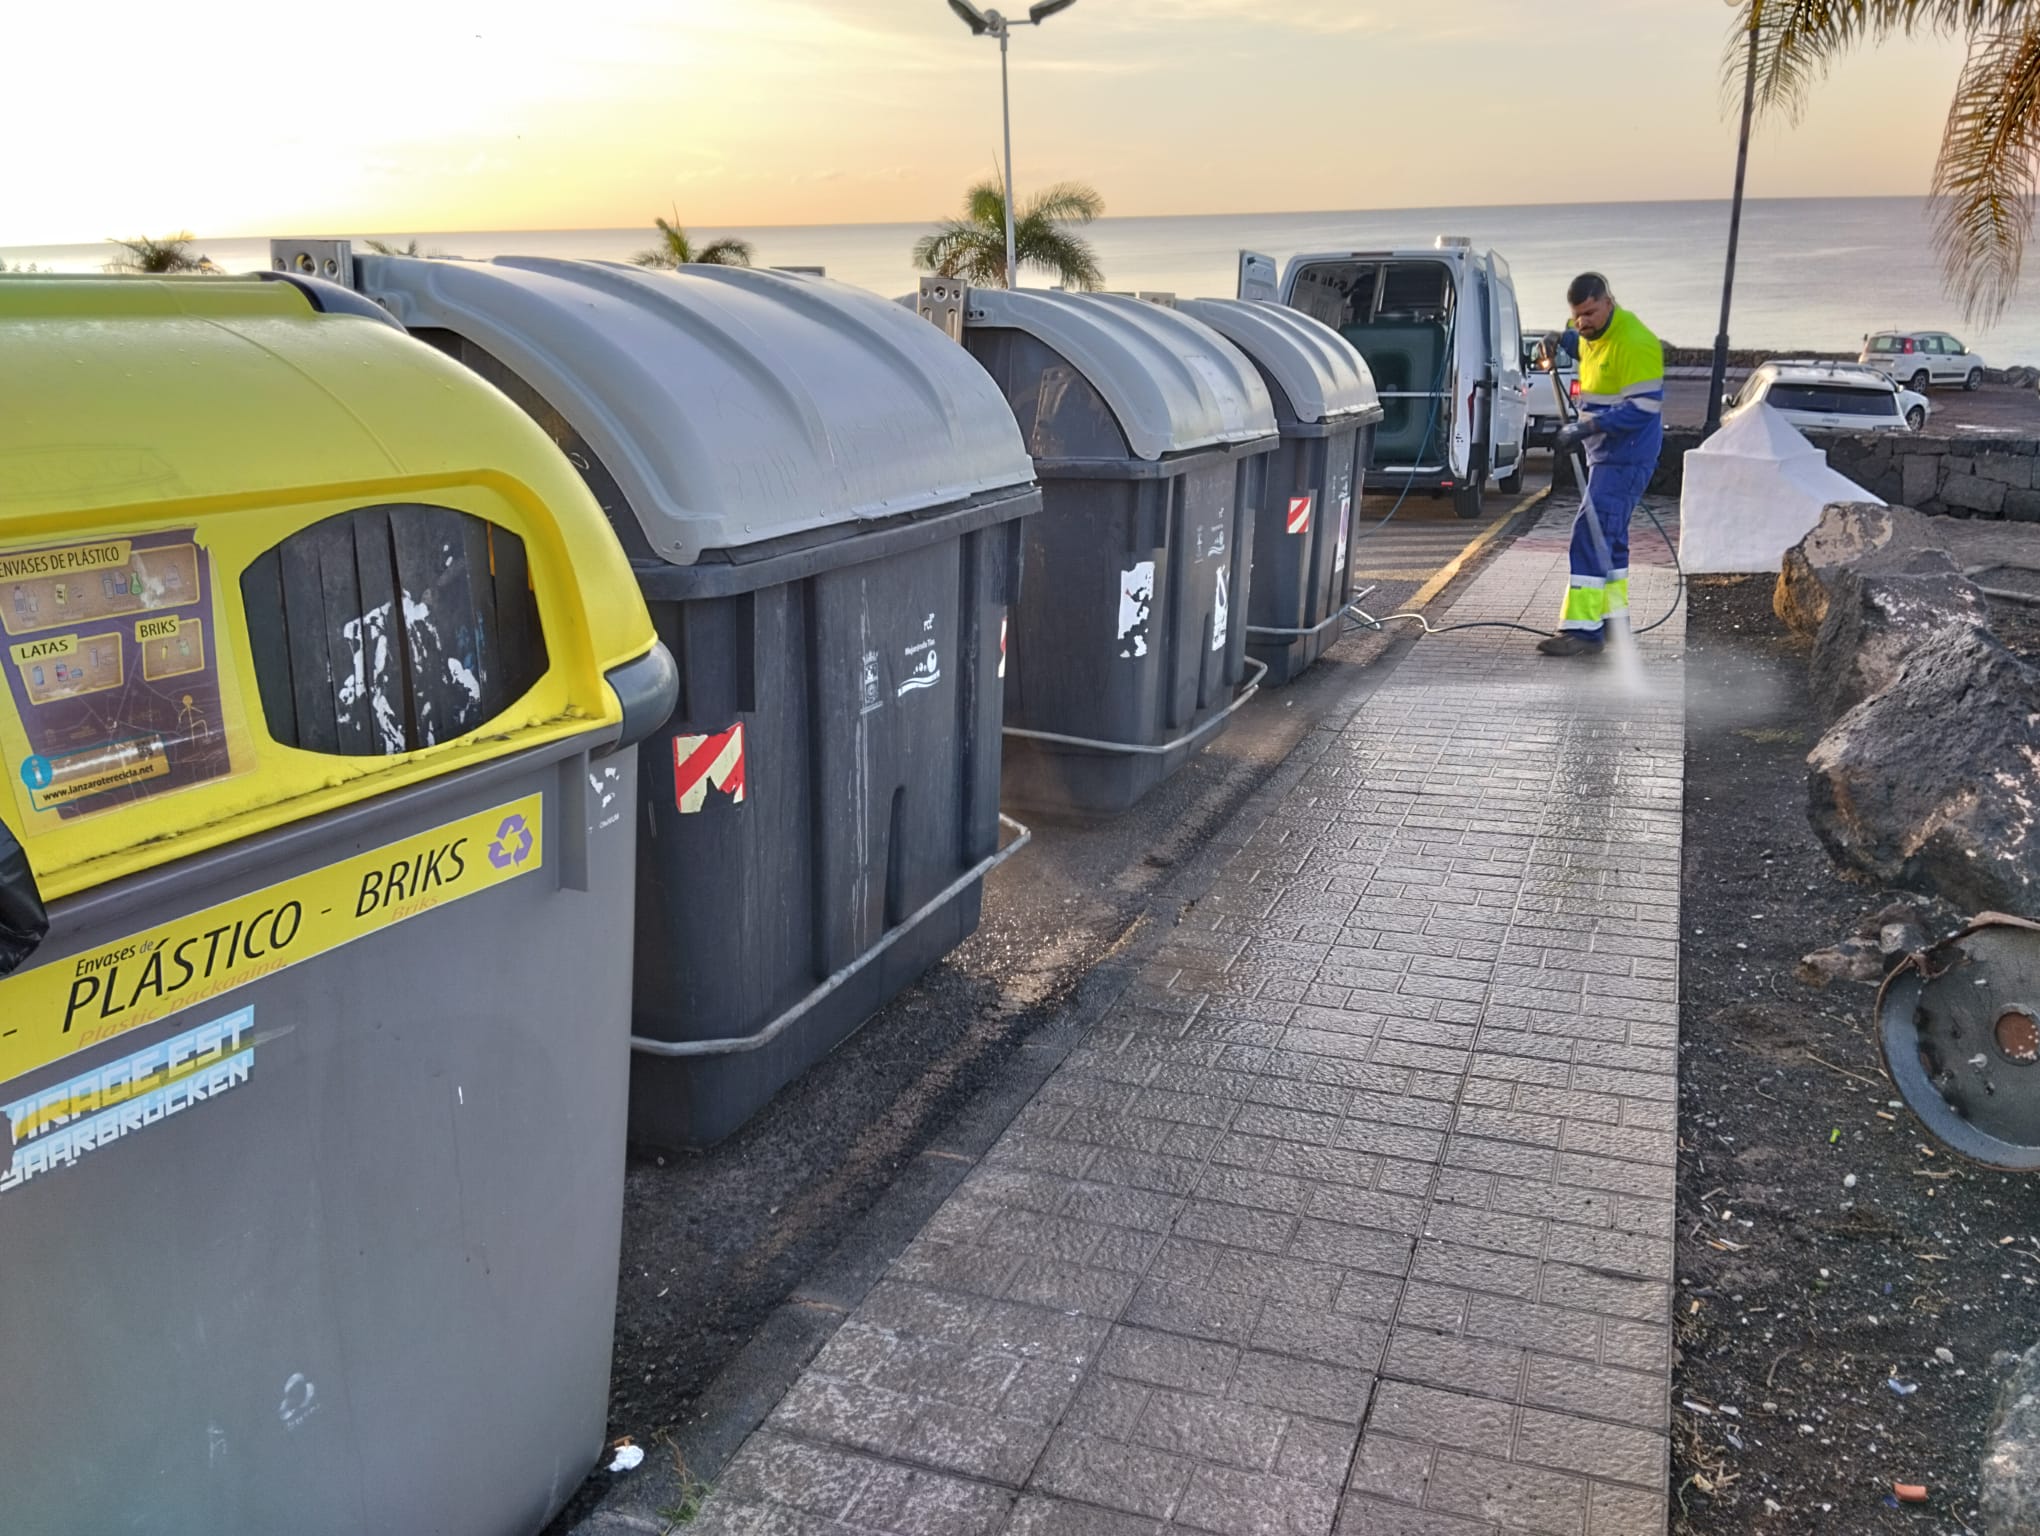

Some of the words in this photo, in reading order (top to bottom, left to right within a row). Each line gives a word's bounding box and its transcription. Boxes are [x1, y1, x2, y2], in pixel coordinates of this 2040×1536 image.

[50, 553, 67, 570] DE
[67, 546, 120, 568] PLÁSTICO
[139, 619, 177, 638] BRIKS
[21, 639, 69, 660] LATAS
[42, 763, 155, 801] www.lanzaroterecicla.net
[391, 896, 439, 921] Briks
[61, 900, 303, 1034] PLÁSTICO
[355, 837, 468, 918] BRIKS
[75, 944, 136, 978] Envases
[139, 939, 154, 955] de
[78, 1003, 157, 1049] Plastic
[168, 1014, 249, 1079] EST
